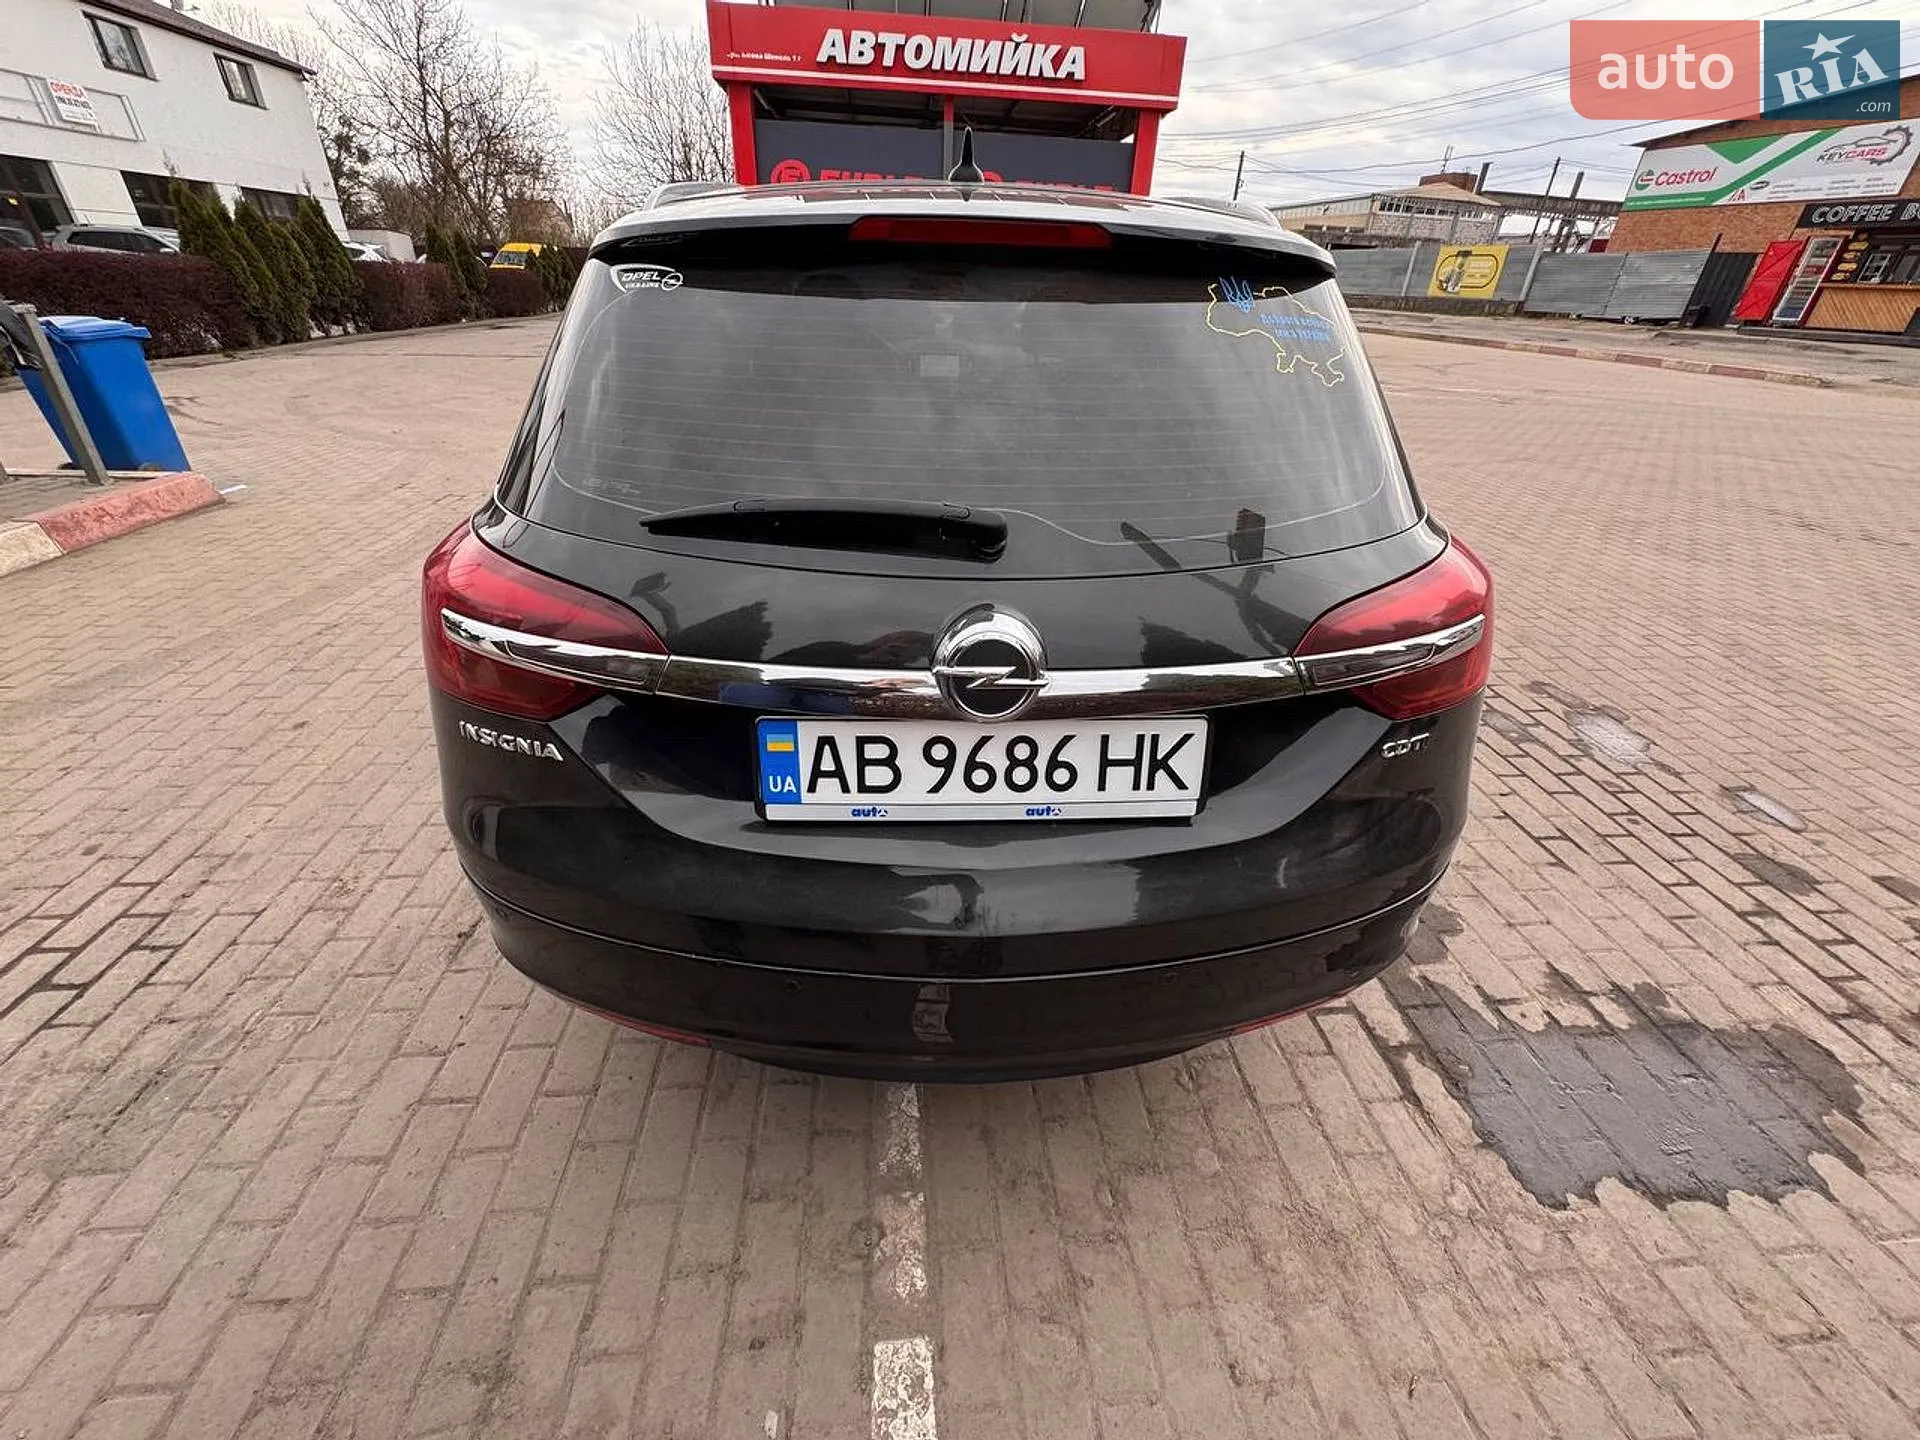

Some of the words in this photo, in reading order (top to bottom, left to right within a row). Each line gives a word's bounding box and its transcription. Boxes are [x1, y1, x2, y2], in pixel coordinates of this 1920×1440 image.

[815, 28, 1087, 81] АВТОМИЙКА
[1654, 167, 1718, 187] Castrol
[1811, 203, 1897, 223] COFFEE
[622, 271, 661, 281] OPEL
[459, 720, 564, 761] INSIGNIA
[806, 734, 902, 794] AB
[922, 735, 1078, 794] 9686
[1099, 733, 1195, 792] HK
[769, 777, 797, 793] UA
